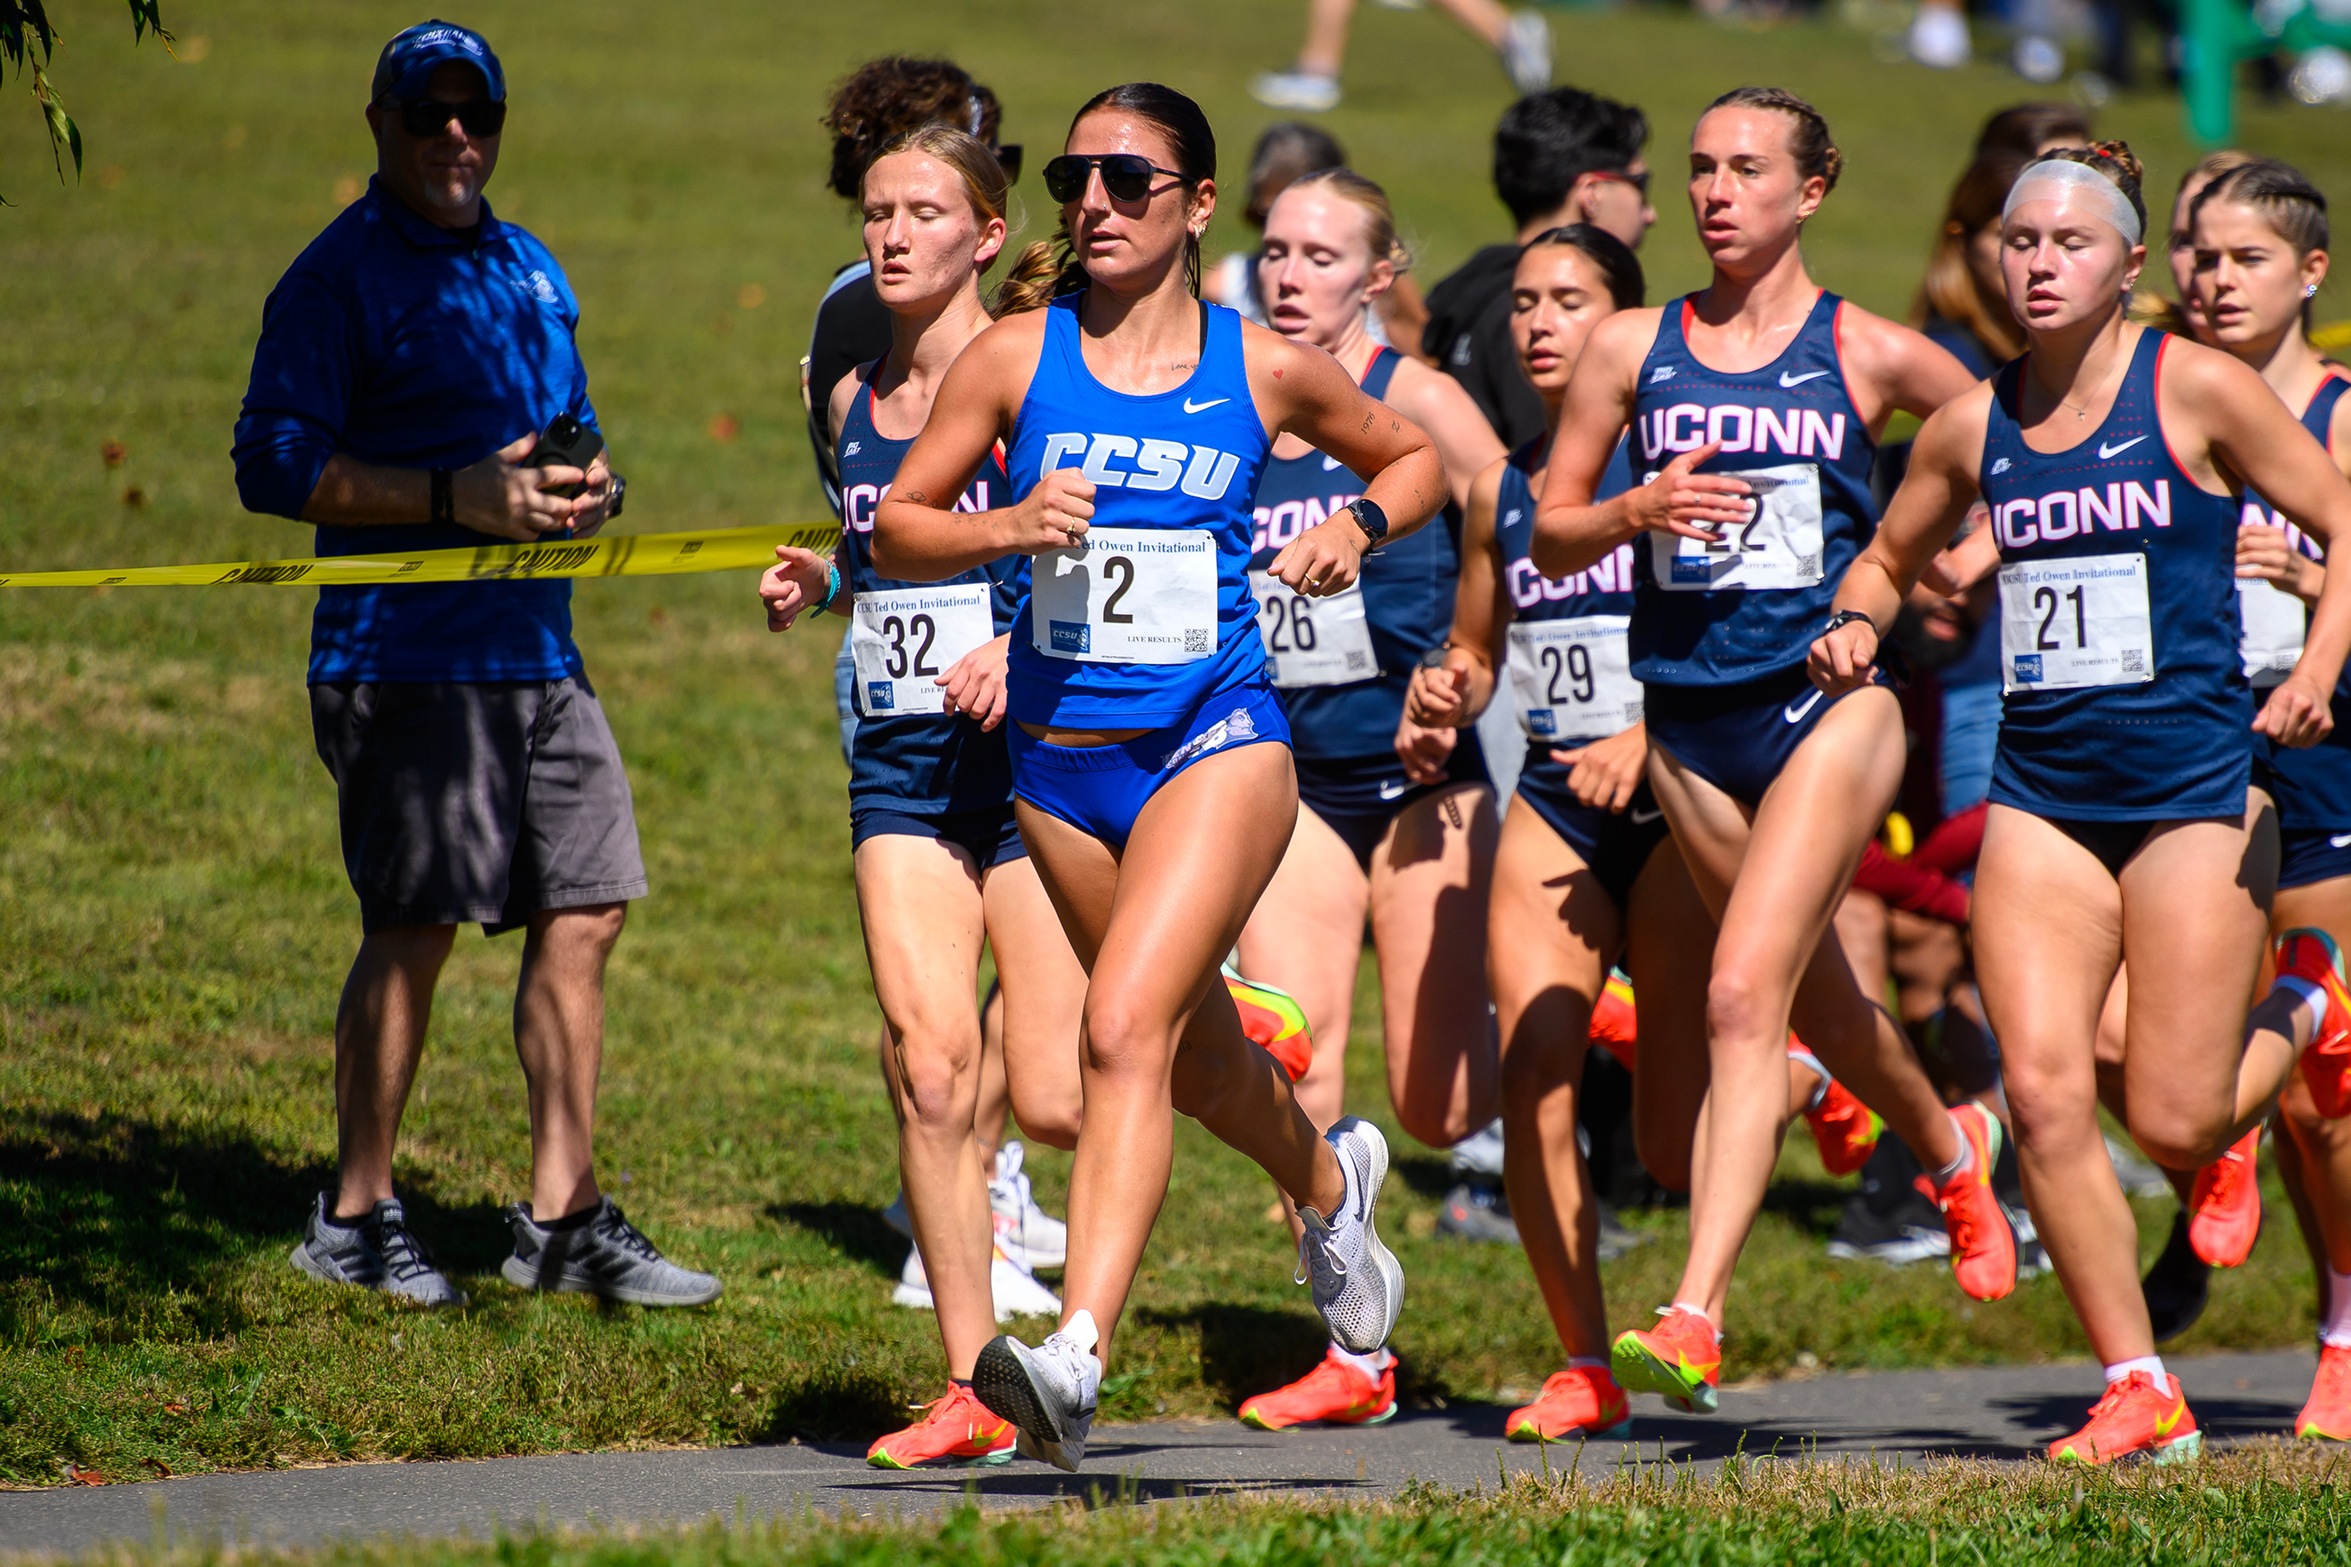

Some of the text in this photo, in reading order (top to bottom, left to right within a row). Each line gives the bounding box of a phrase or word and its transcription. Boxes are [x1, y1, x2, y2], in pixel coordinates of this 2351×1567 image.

[1361, 411, 1376, 435] 1976
[1639, 403, 1845, 460] UCONN
[1040, 432, 1240, 500] CCSU
[498, 544, 600, 573] CAUTION
[1099, 540, 1134, 552] Owen
[1138, 541, 1206, 553] Invitational
[209, 564, 315, 585] CAUTION
[1103, 556, 1135, 625] 2
[2023, 572, 2040, 583] Ted
[2043, 570, 2071, 581] Owen
[2073, 566, 2136, 580] Invitational
[857, 595, 980, 613] CCSU Ted Owen Invitational
[1267, 595, 1316, 652] 26
[2034, 585, 2087, 650] 21
[883, 614, 939, 679] 32
[1053, 629, 1077, 640] CCSU
[1541, 644, 1595, 706] 29
